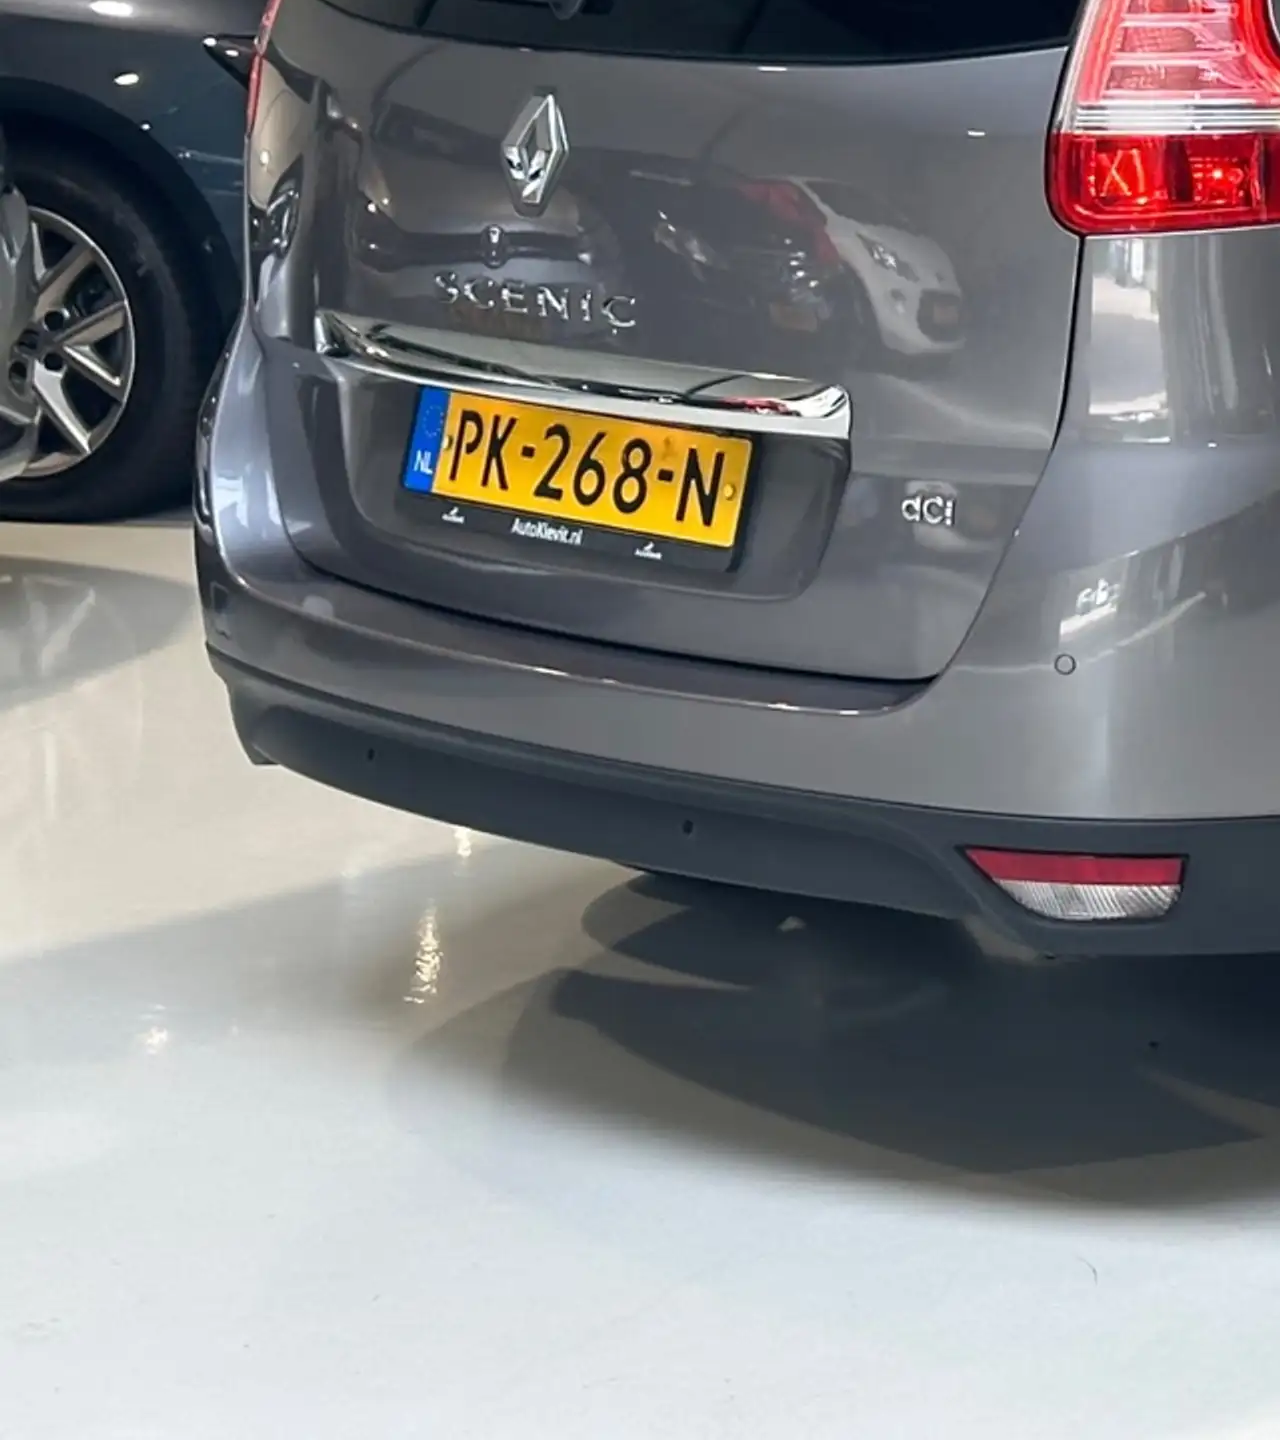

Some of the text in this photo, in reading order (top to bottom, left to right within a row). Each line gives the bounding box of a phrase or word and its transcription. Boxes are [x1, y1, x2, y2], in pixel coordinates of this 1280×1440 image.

[434, 271, 637, 334] SCENIC
[413, 449, 434, 475] NL
[449, 408, 726, 527] PK-268-N
